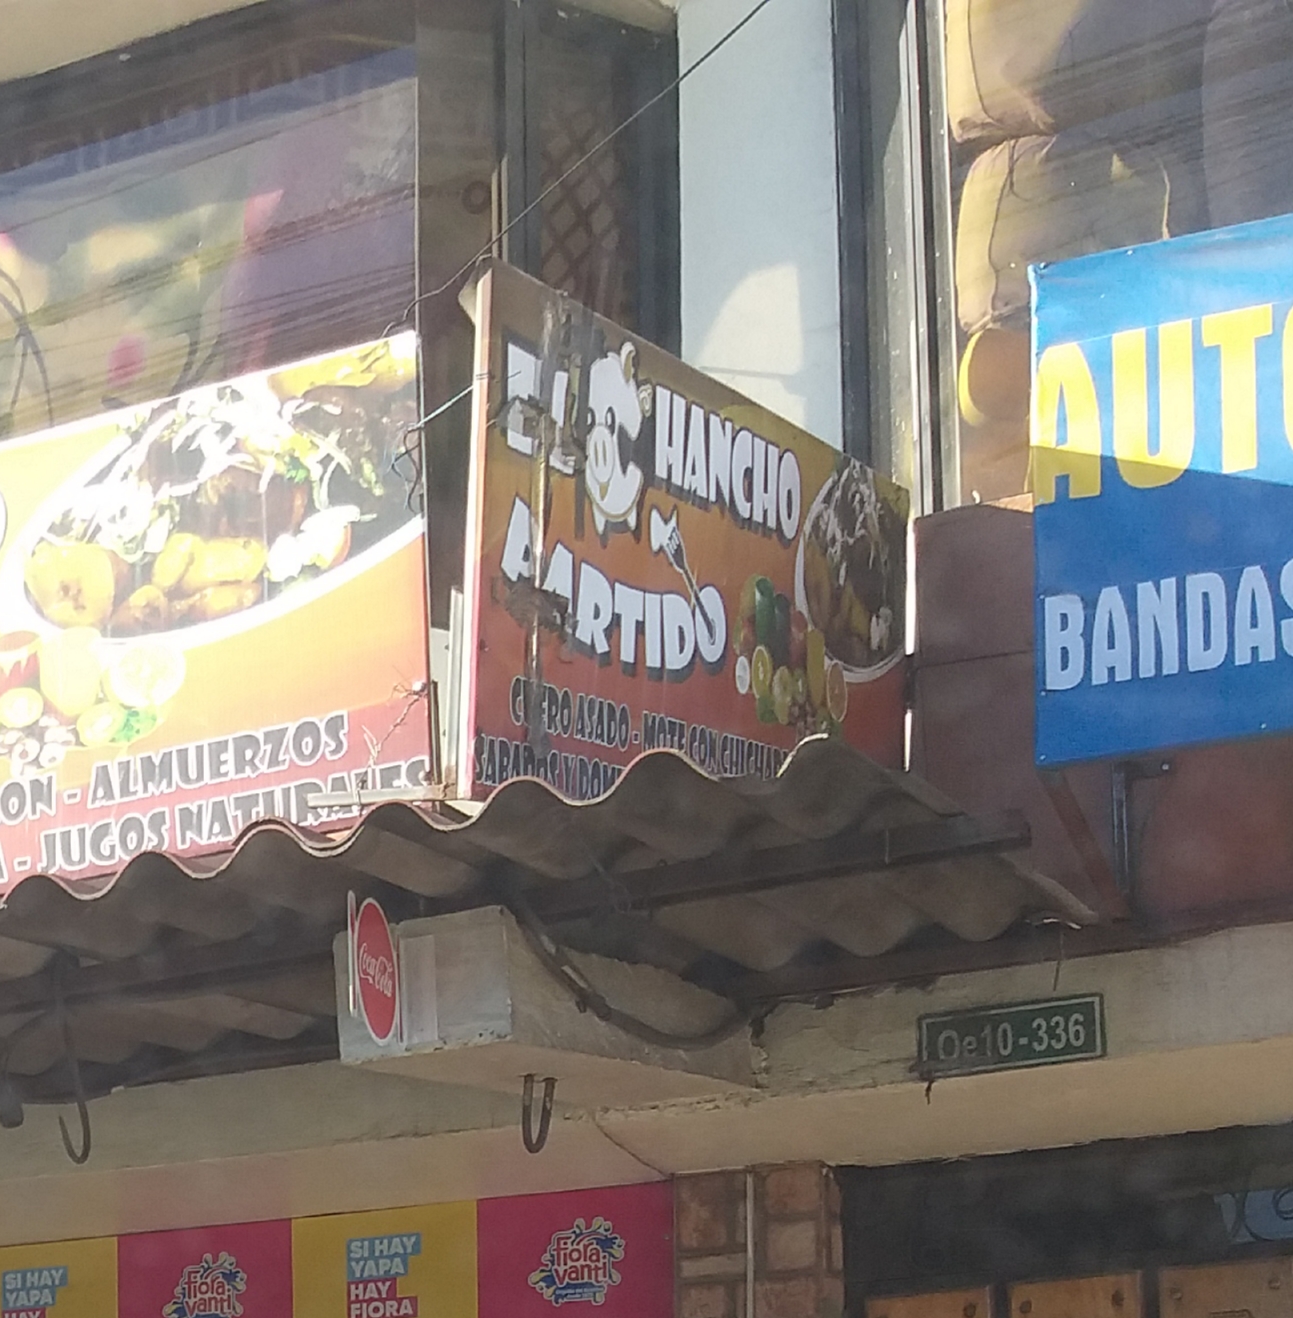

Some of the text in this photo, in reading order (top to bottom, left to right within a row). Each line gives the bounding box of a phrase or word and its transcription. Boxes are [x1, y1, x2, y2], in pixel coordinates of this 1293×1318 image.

[508, 342, 576, 475] EL
[1033, 303, 1293, 506] AUT
[574, 693, 631, 752] ASADO
[89, 712, 347, 807] ALMUERZOS
[40, 808, 169, 873] JUGOS
[937, 1013, 1086, 1060] Oe10-336
[349, 1236, 417, 1258] SI HAY
[350, 1257, 406, 1278] YAPA
[4, 1268, 64, 1290] SI HAY
[5, 1289, 54, 1307] YAPA
[349, 1281, 392, 1300] HAY
